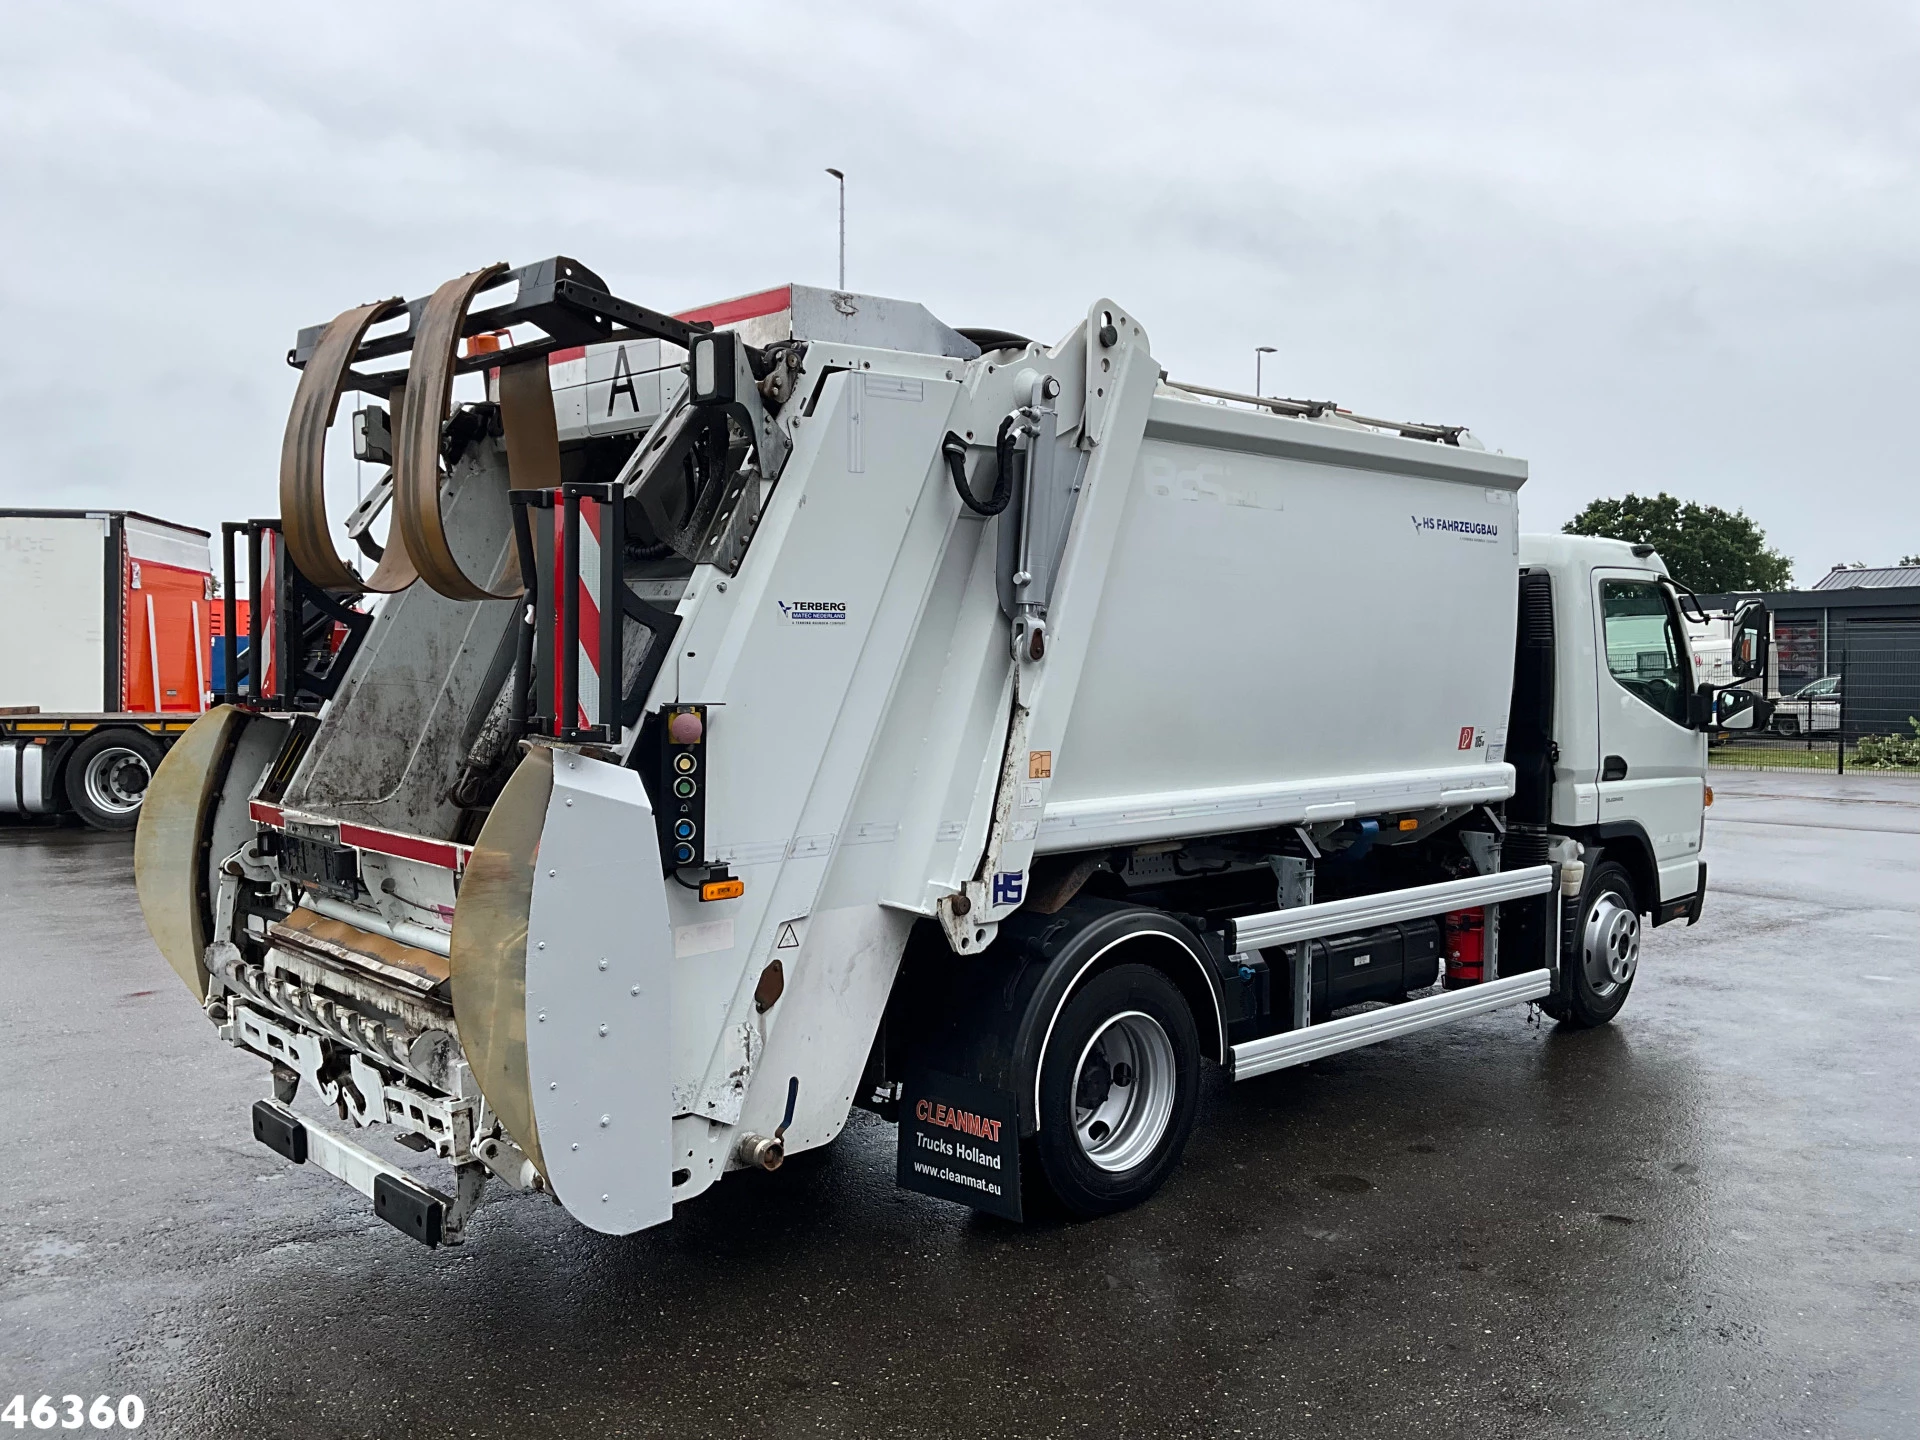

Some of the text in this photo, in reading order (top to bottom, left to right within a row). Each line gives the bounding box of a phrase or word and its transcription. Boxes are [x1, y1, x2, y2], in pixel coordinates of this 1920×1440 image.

[607, 345, 640, 417] A
[1423, 517, 1498, 536] HS FAHRZEUGBAU
[792, 602, 846, 611] TERBERG
[993, 871, 1023, 905] HS
[916, 1099, 1001, 1143] CLEANMAT
[916, 1132, 1001, 1170] Trucks Holland
[914, 1161, 1002, 1195] www.cleanmat.eu
